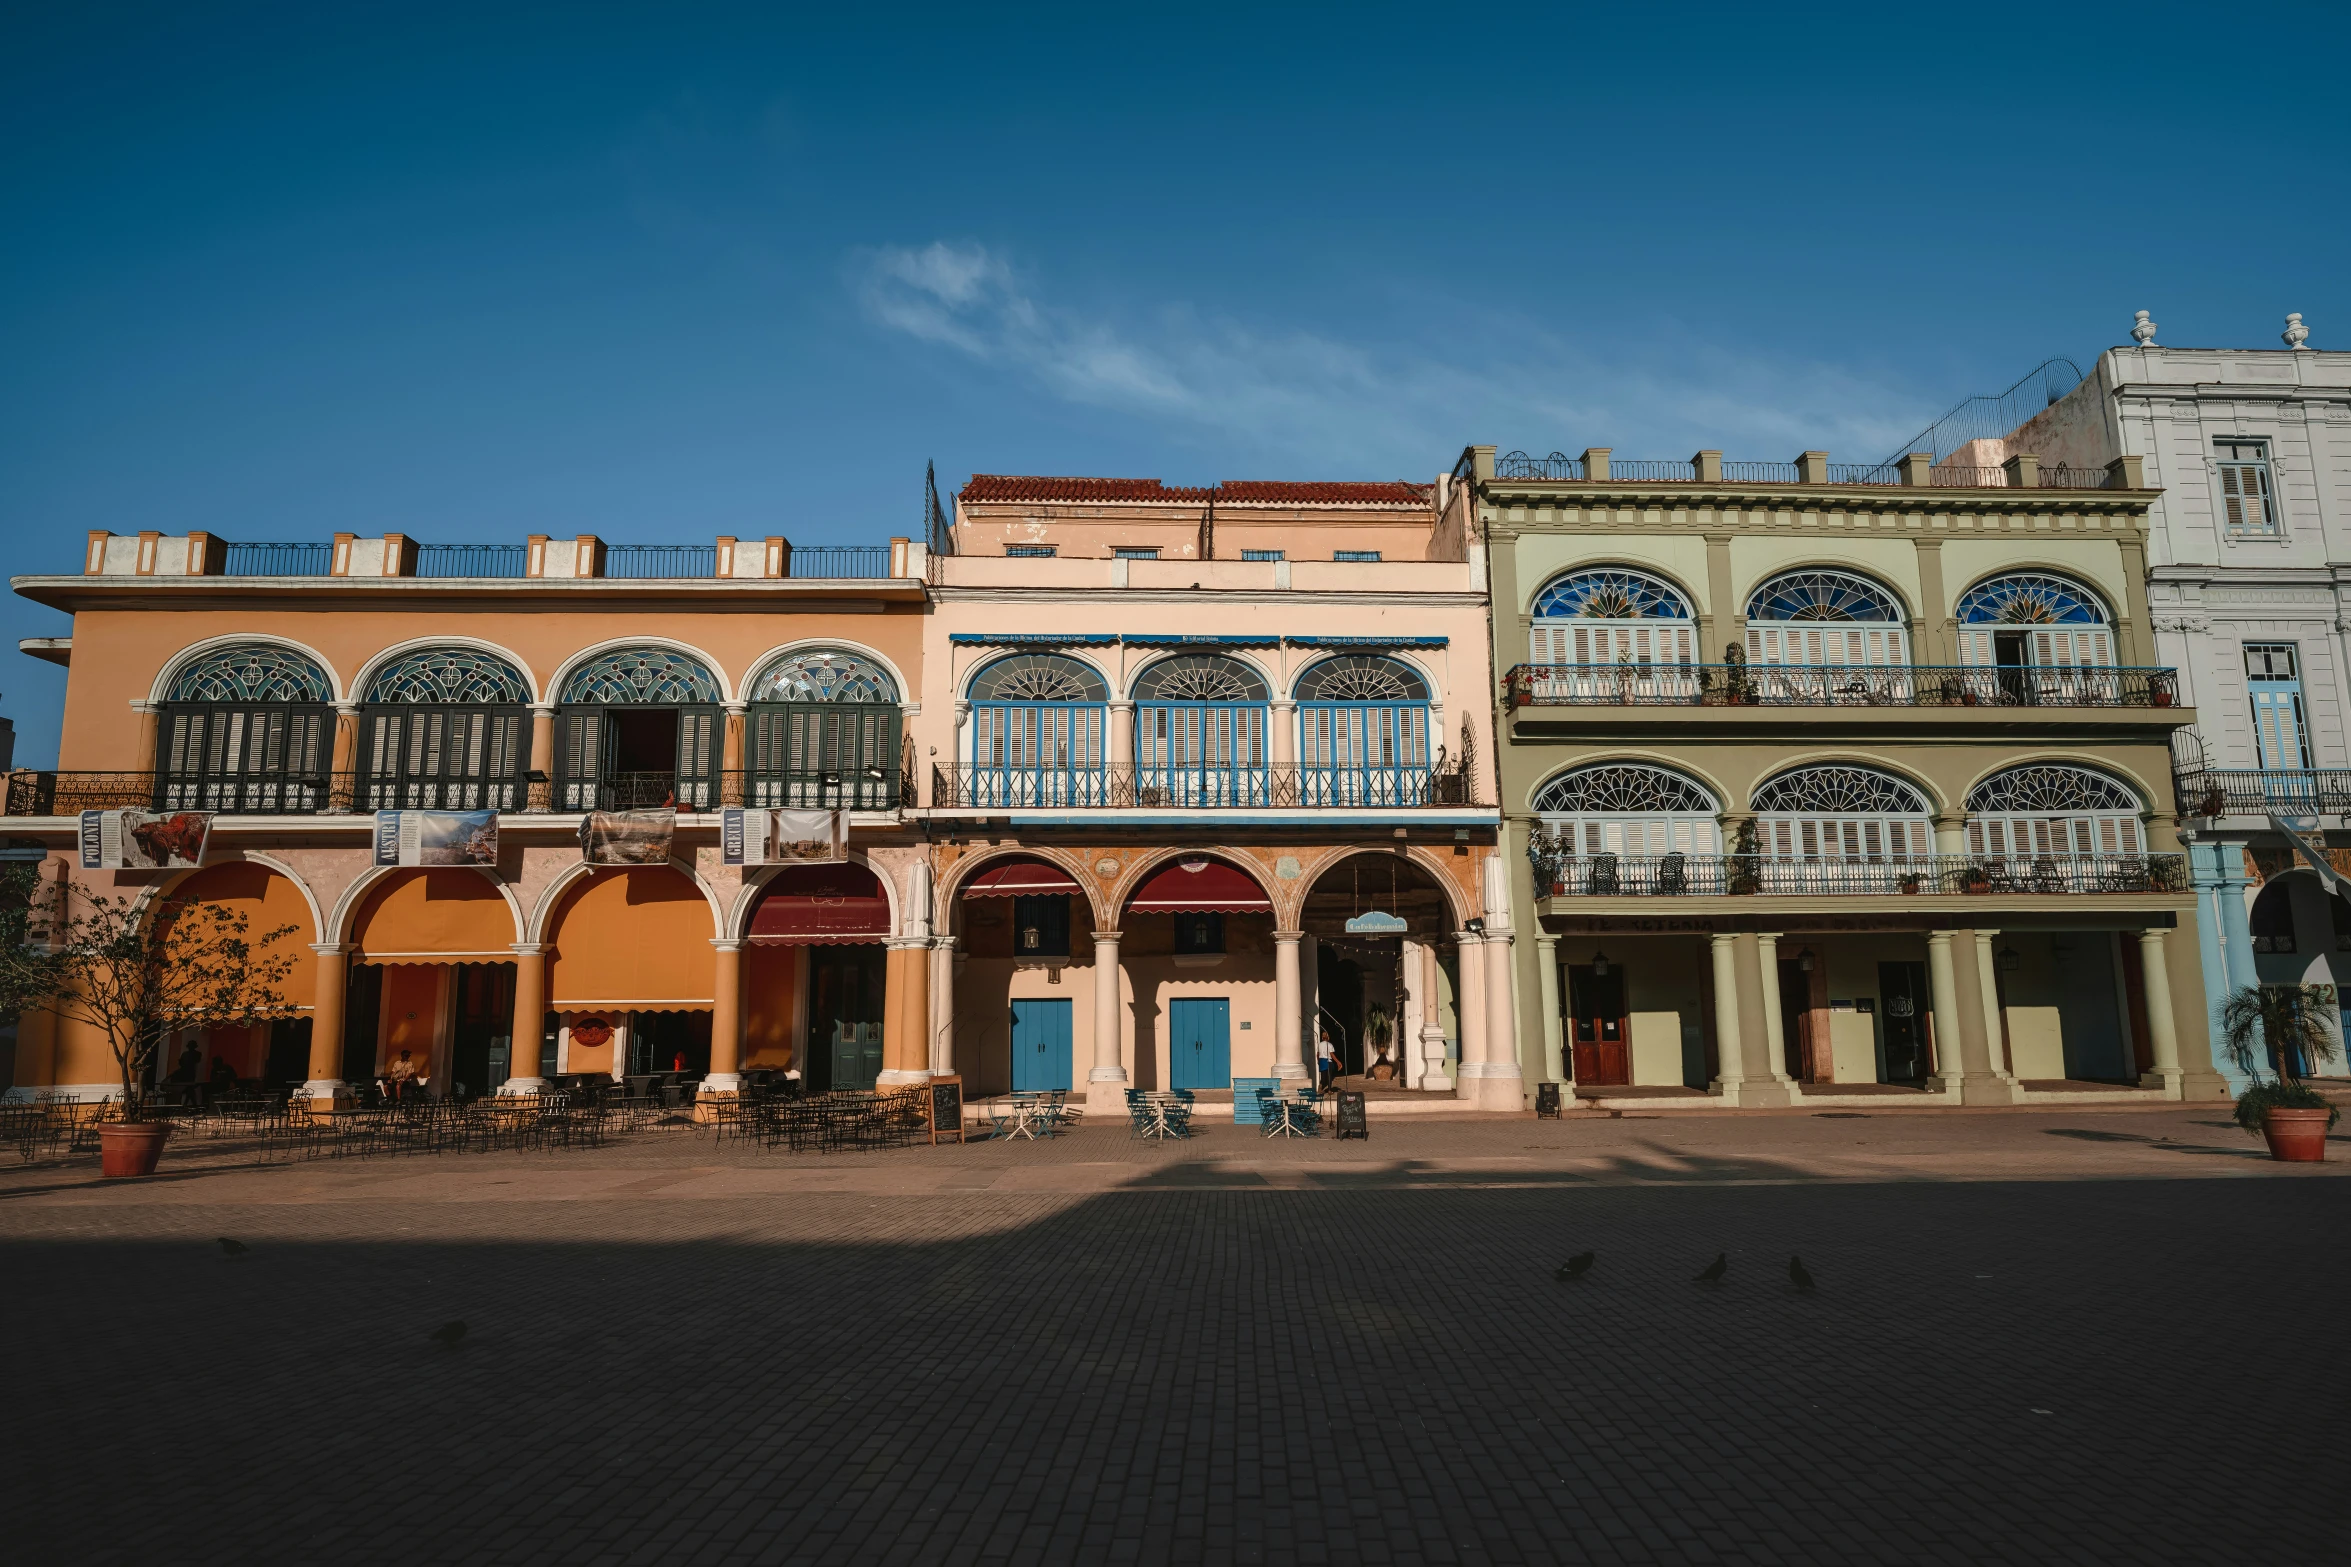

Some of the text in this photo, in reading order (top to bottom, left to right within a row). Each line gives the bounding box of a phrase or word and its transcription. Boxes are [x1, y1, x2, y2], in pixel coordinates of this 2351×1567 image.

[84, 815, 99, 863] POLONIA
[381, 813, 397, 861] AUSTRIA
[727, 816, 741, 856] GRECIA
